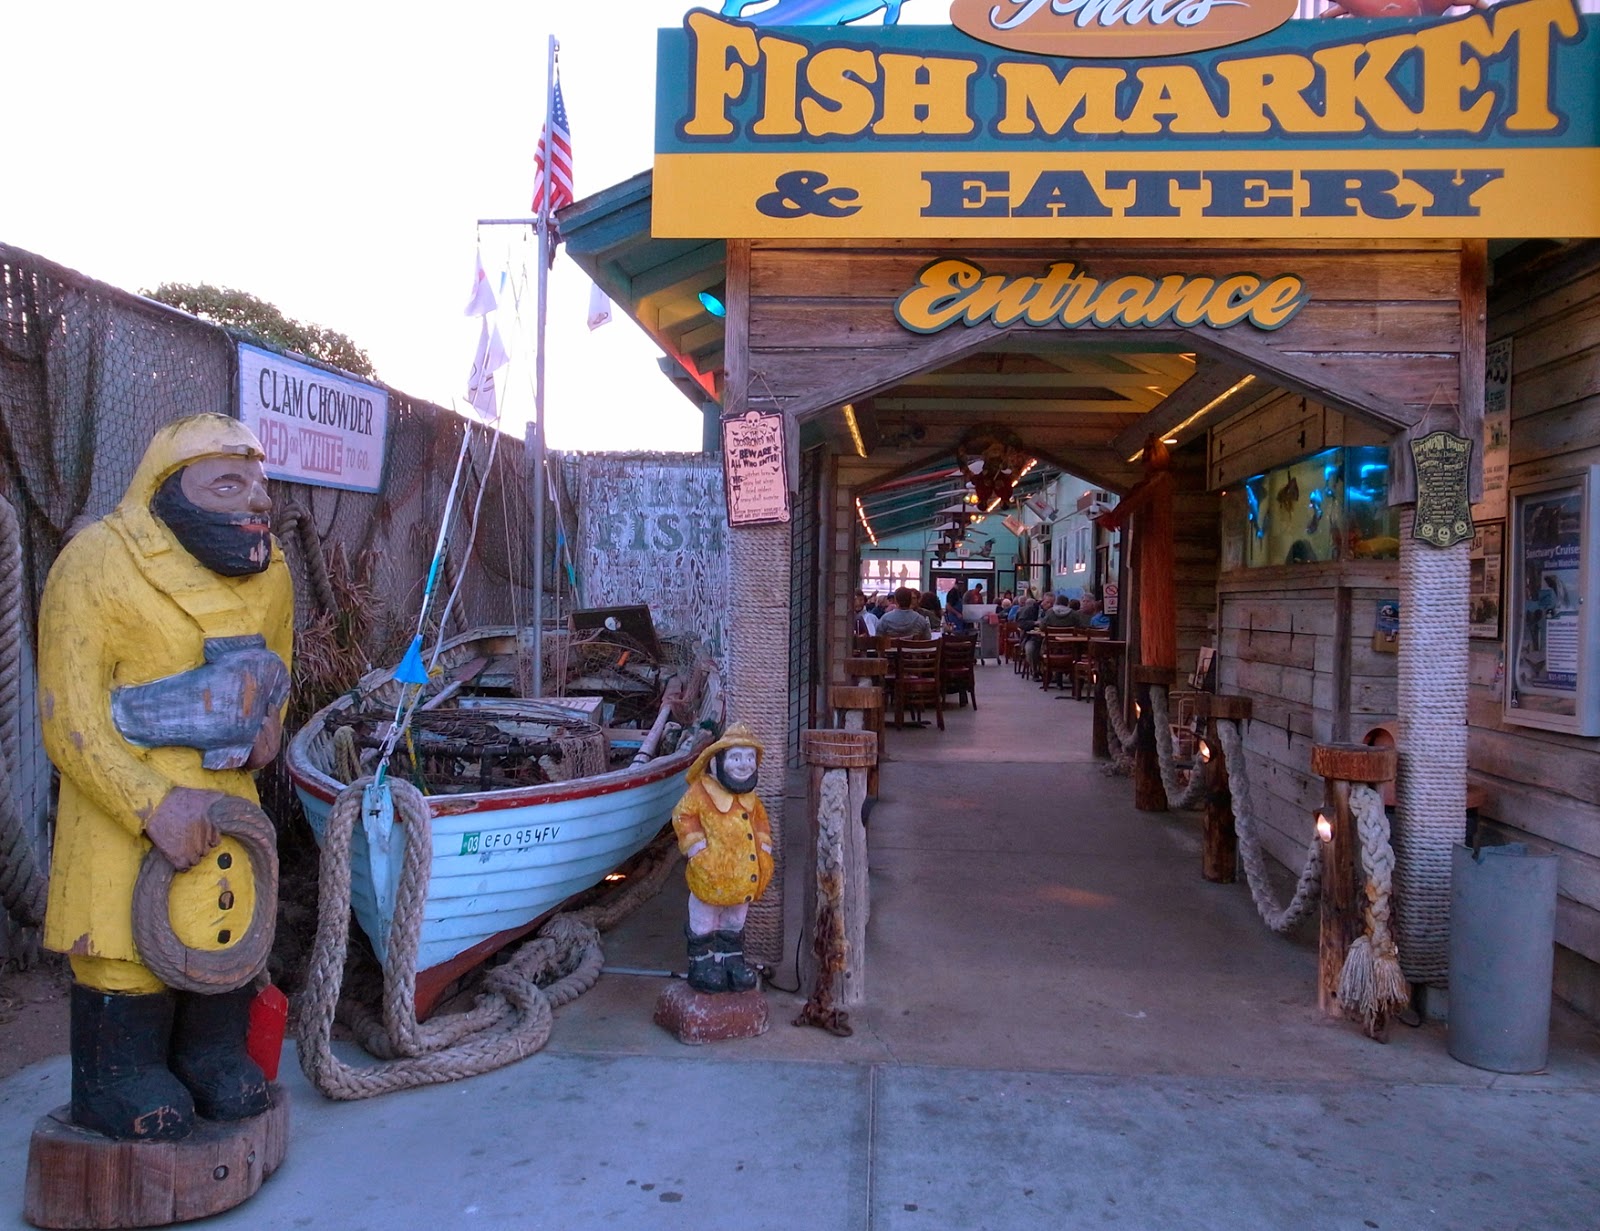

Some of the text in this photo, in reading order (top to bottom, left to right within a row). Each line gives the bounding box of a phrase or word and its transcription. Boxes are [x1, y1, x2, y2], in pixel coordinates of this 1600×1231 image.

[684, 0, 1580, 137] FISH MARKET
[756, 169, 1505, 219] & EATERY
[898, 257, 1304, 330] Entrance
[259, 367, 374, 436] CLAM CHOWDER
[259, 417, 289, 467] RED
[299, 428, 344, 476] WHITE
[739, 446, 773, 460] BEWARE
[743, 460, 758, 468] WHO
[595, 513, 726, 551] FISH
[467, 837, 478, 852] 03
